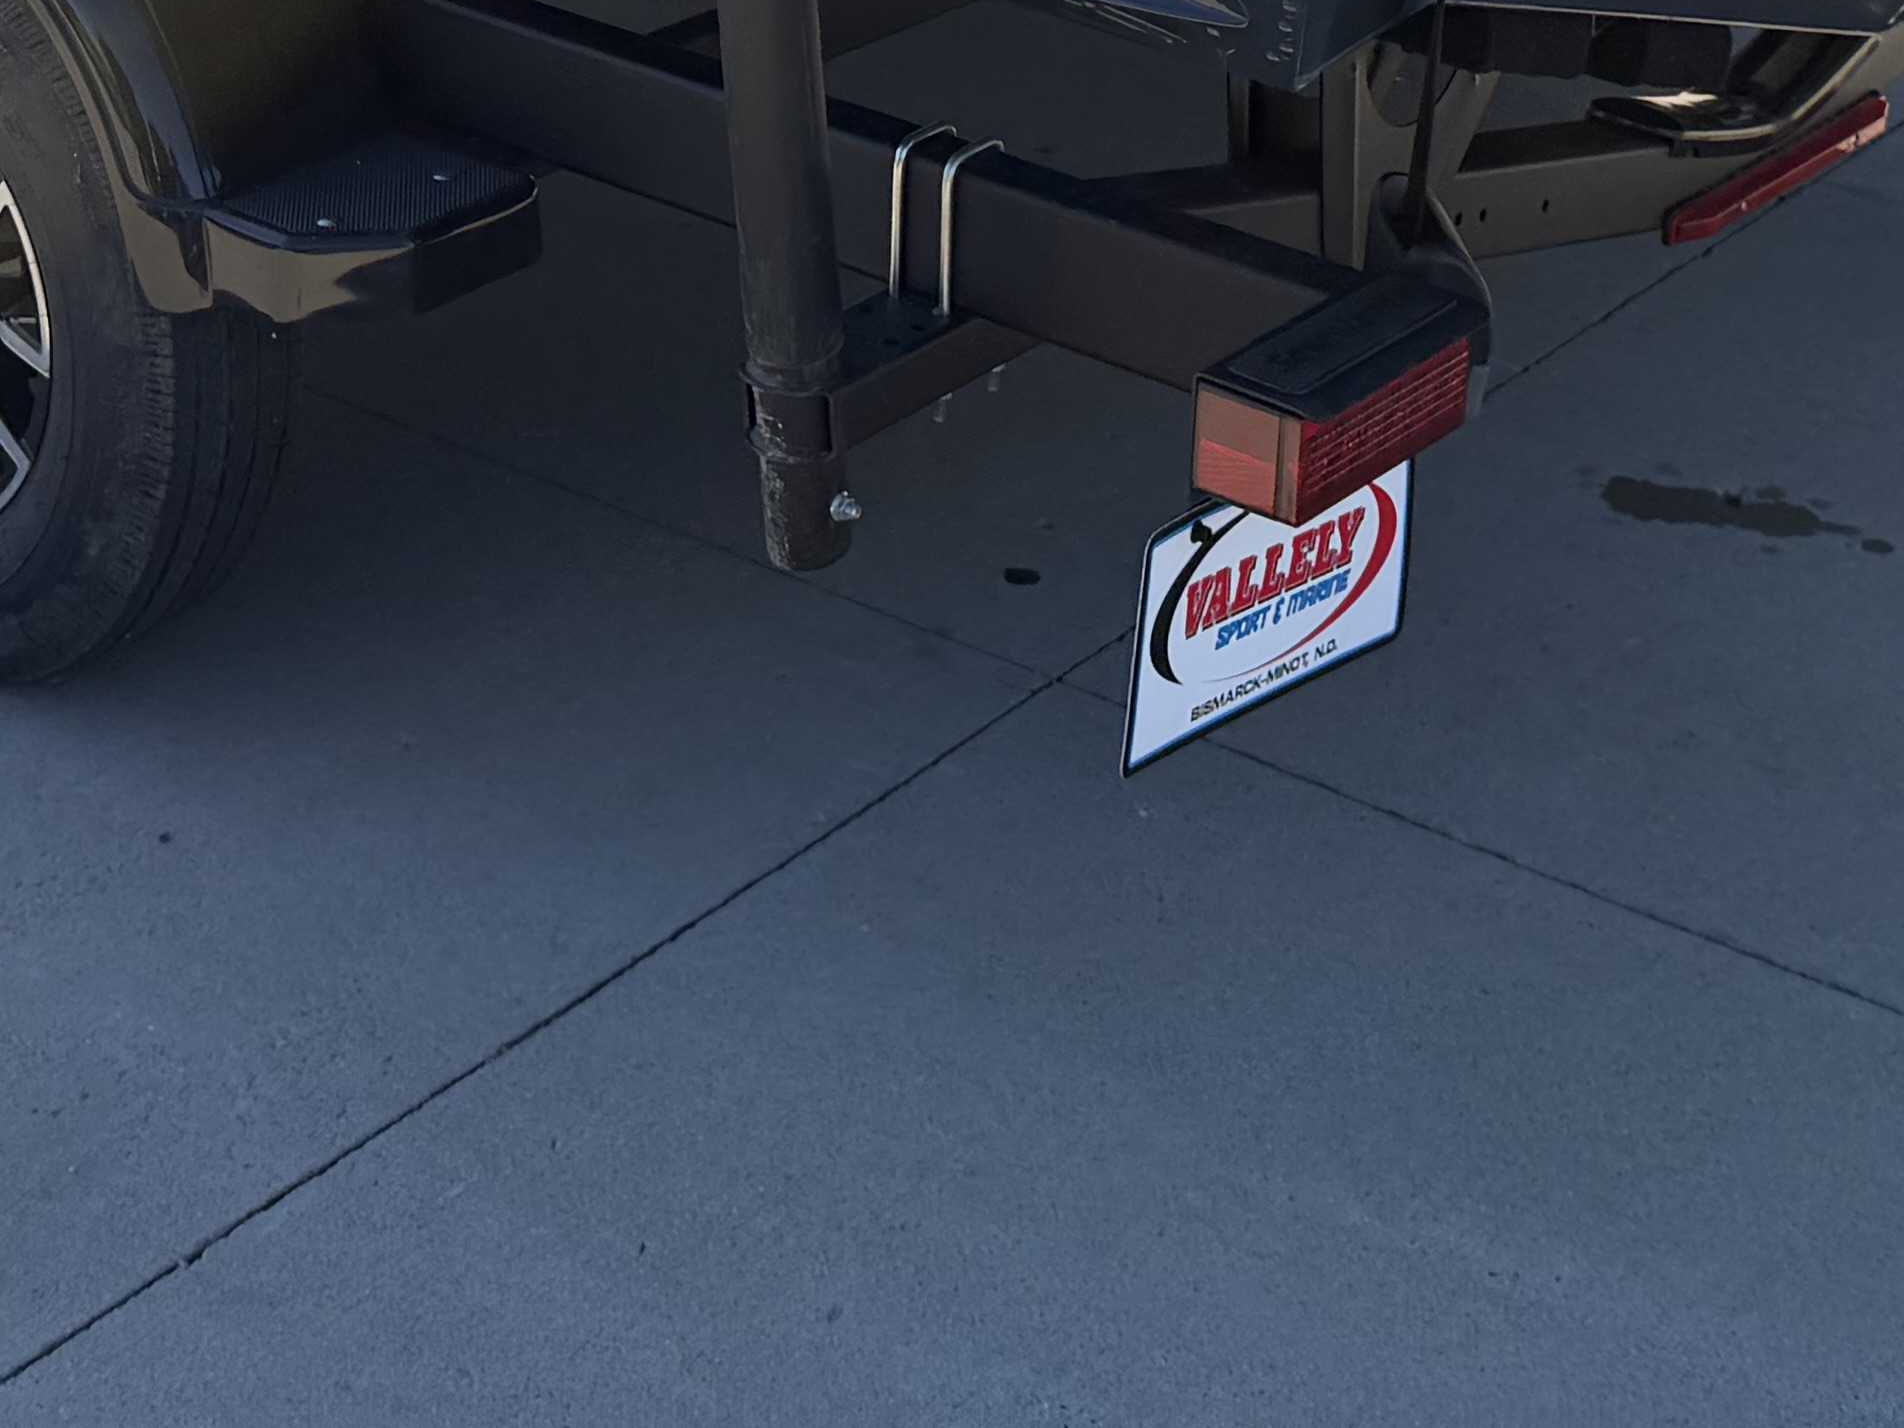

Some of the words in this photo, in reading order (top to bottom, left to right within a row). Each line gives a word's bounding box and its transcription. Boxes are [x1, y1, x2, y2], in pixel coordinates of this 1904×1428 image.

[1185, 506, 1366, 640] VALLELY
[1214, 605, 1271, 651] SPORT
[1286, 568, 1352, 617] MARINE
